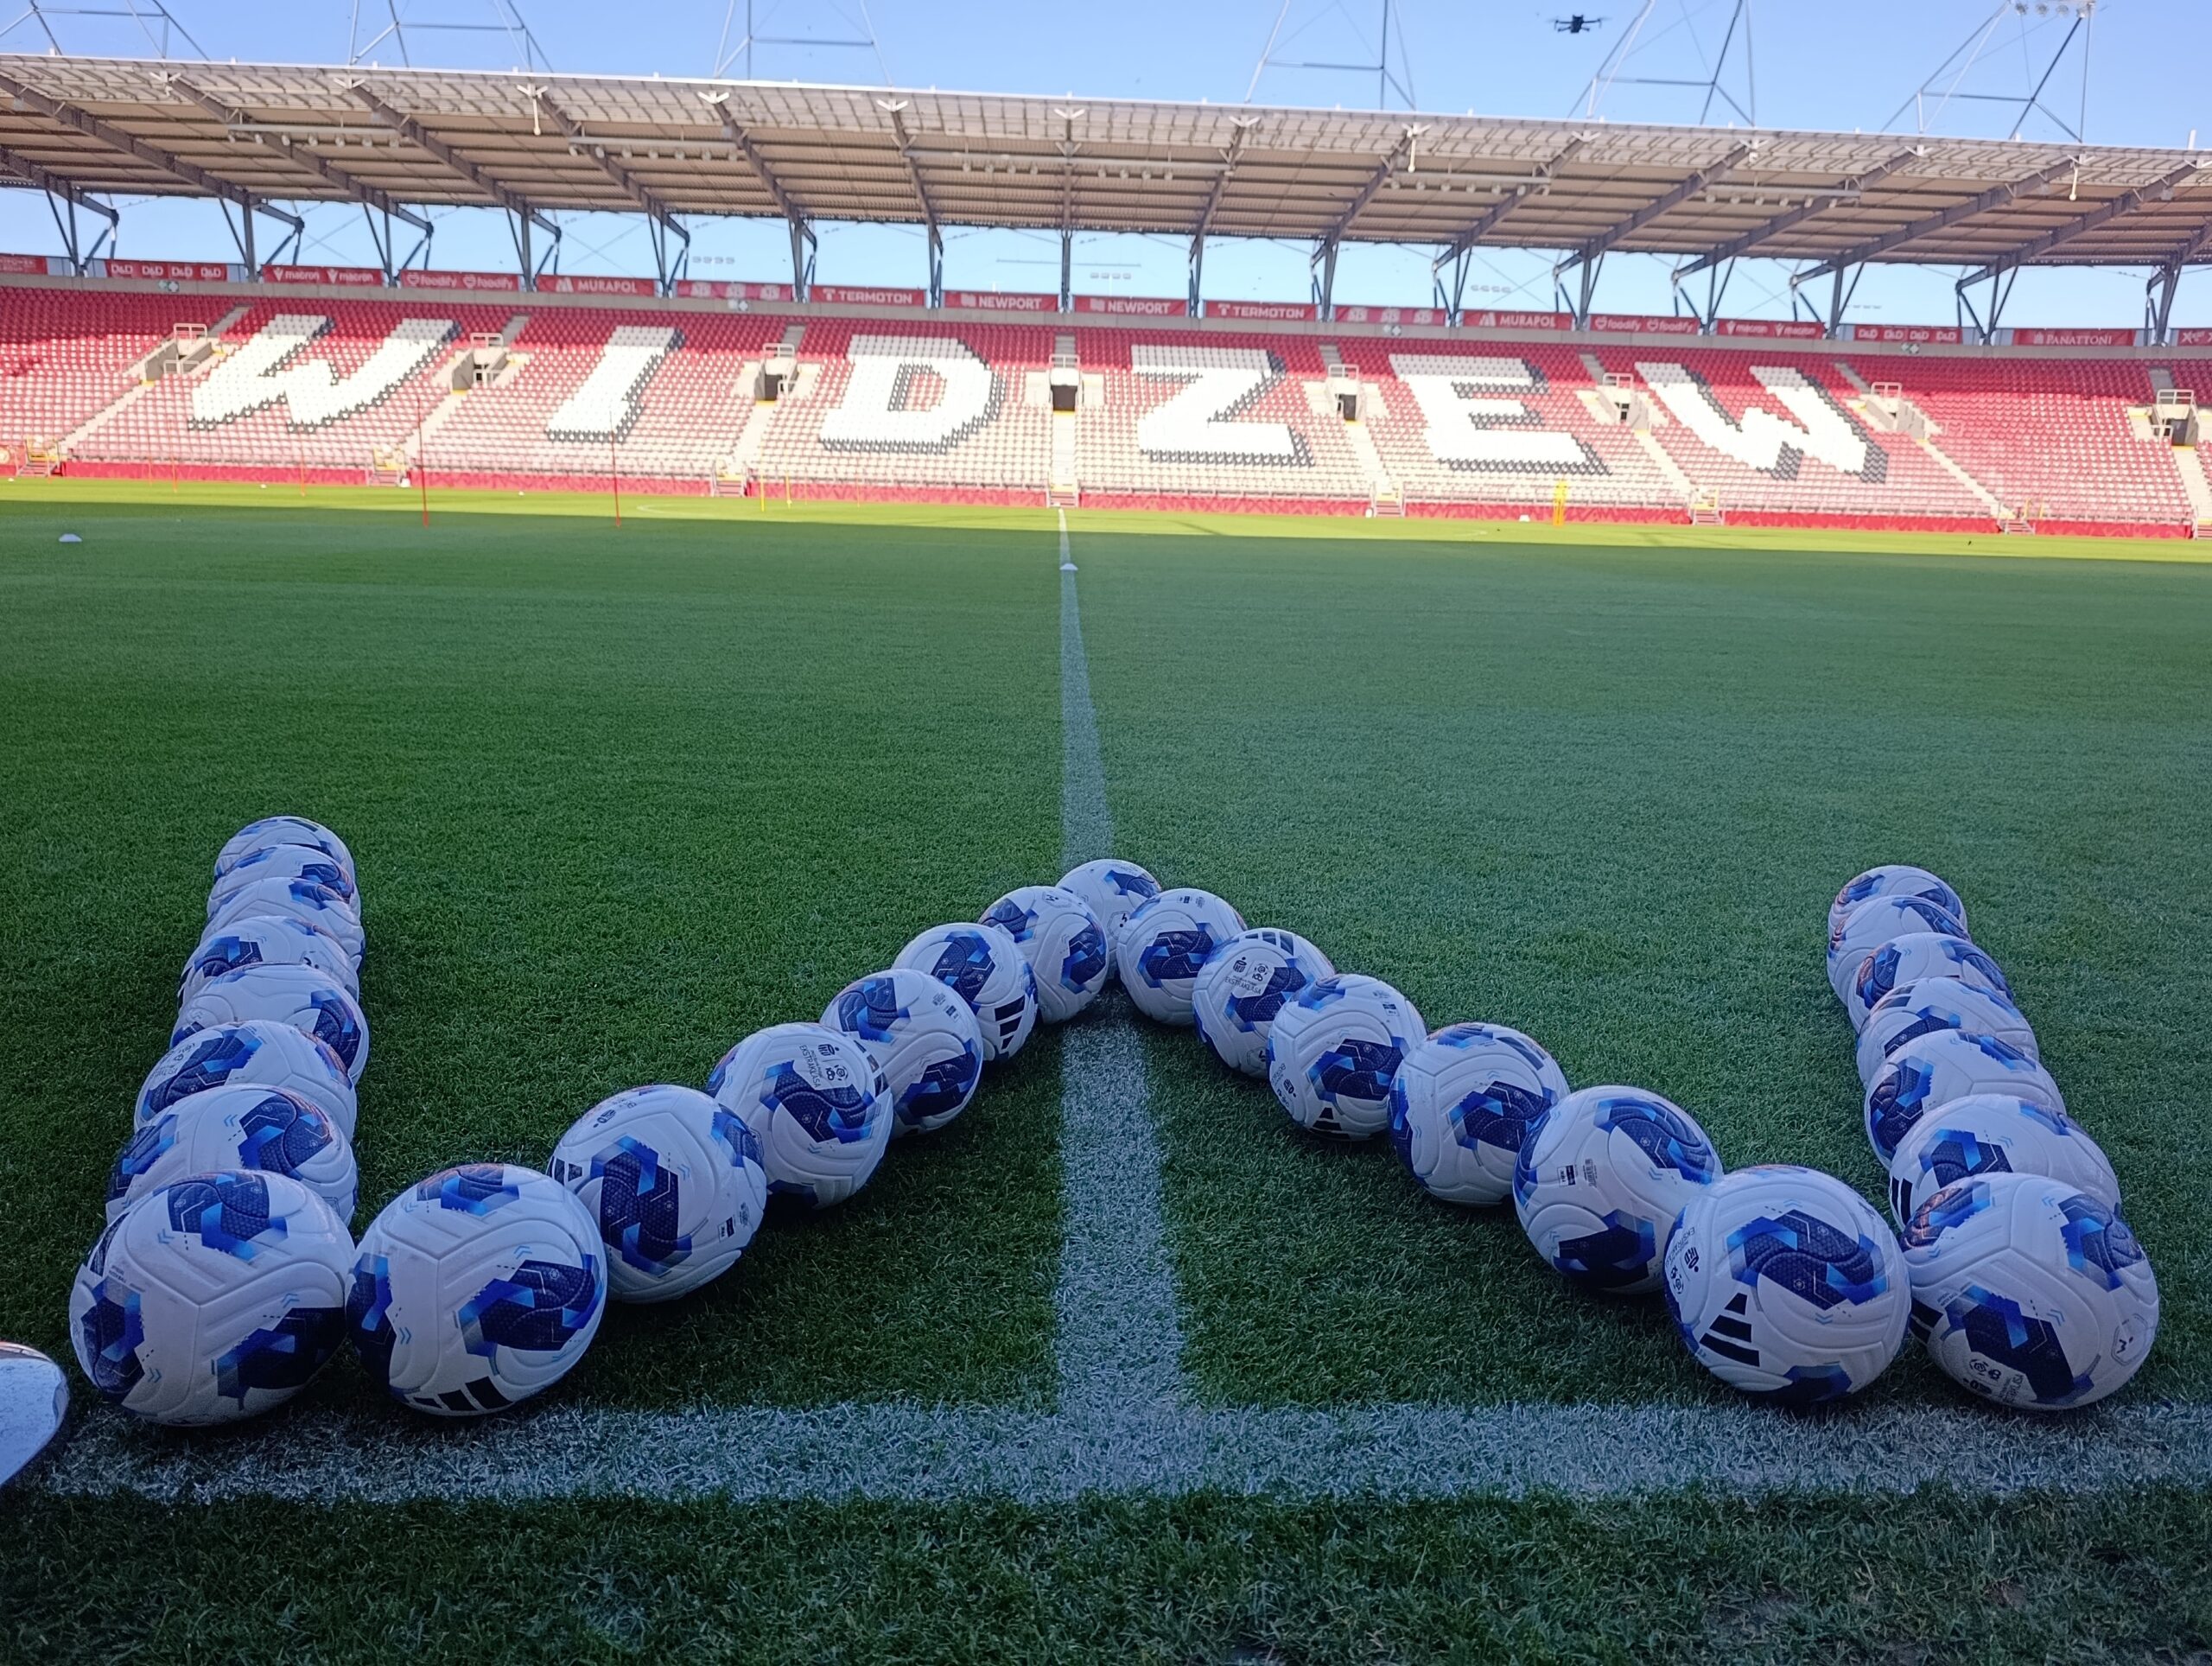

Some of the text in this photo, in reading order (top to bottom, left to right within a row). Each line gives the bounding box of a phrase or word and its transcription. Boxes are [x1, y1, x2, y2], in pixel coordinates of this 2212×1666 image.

[285, 270, 373, 283] macron macron
[420, 274, 513, 289] foodify foodify
[577, 278, 637, 294] MURAPOL
[838, 290, 912, 304] TERMOTON
[978, 296, 1042, 309] NEWPORT
[1107, 301, 1171, 314] NEWPORT
[1232, 306, 1305, 319] TERMOTON
[1499, 315, 1555, 327] MURAPOL
[1608, 319, 1694, 333] foodify foodify
[1735, 324, 1816, 335] macron macron
[2046, 334, 2112, 346] PANATTONI
[798, 1044, 822, 1088] EKSTRAKLASA
